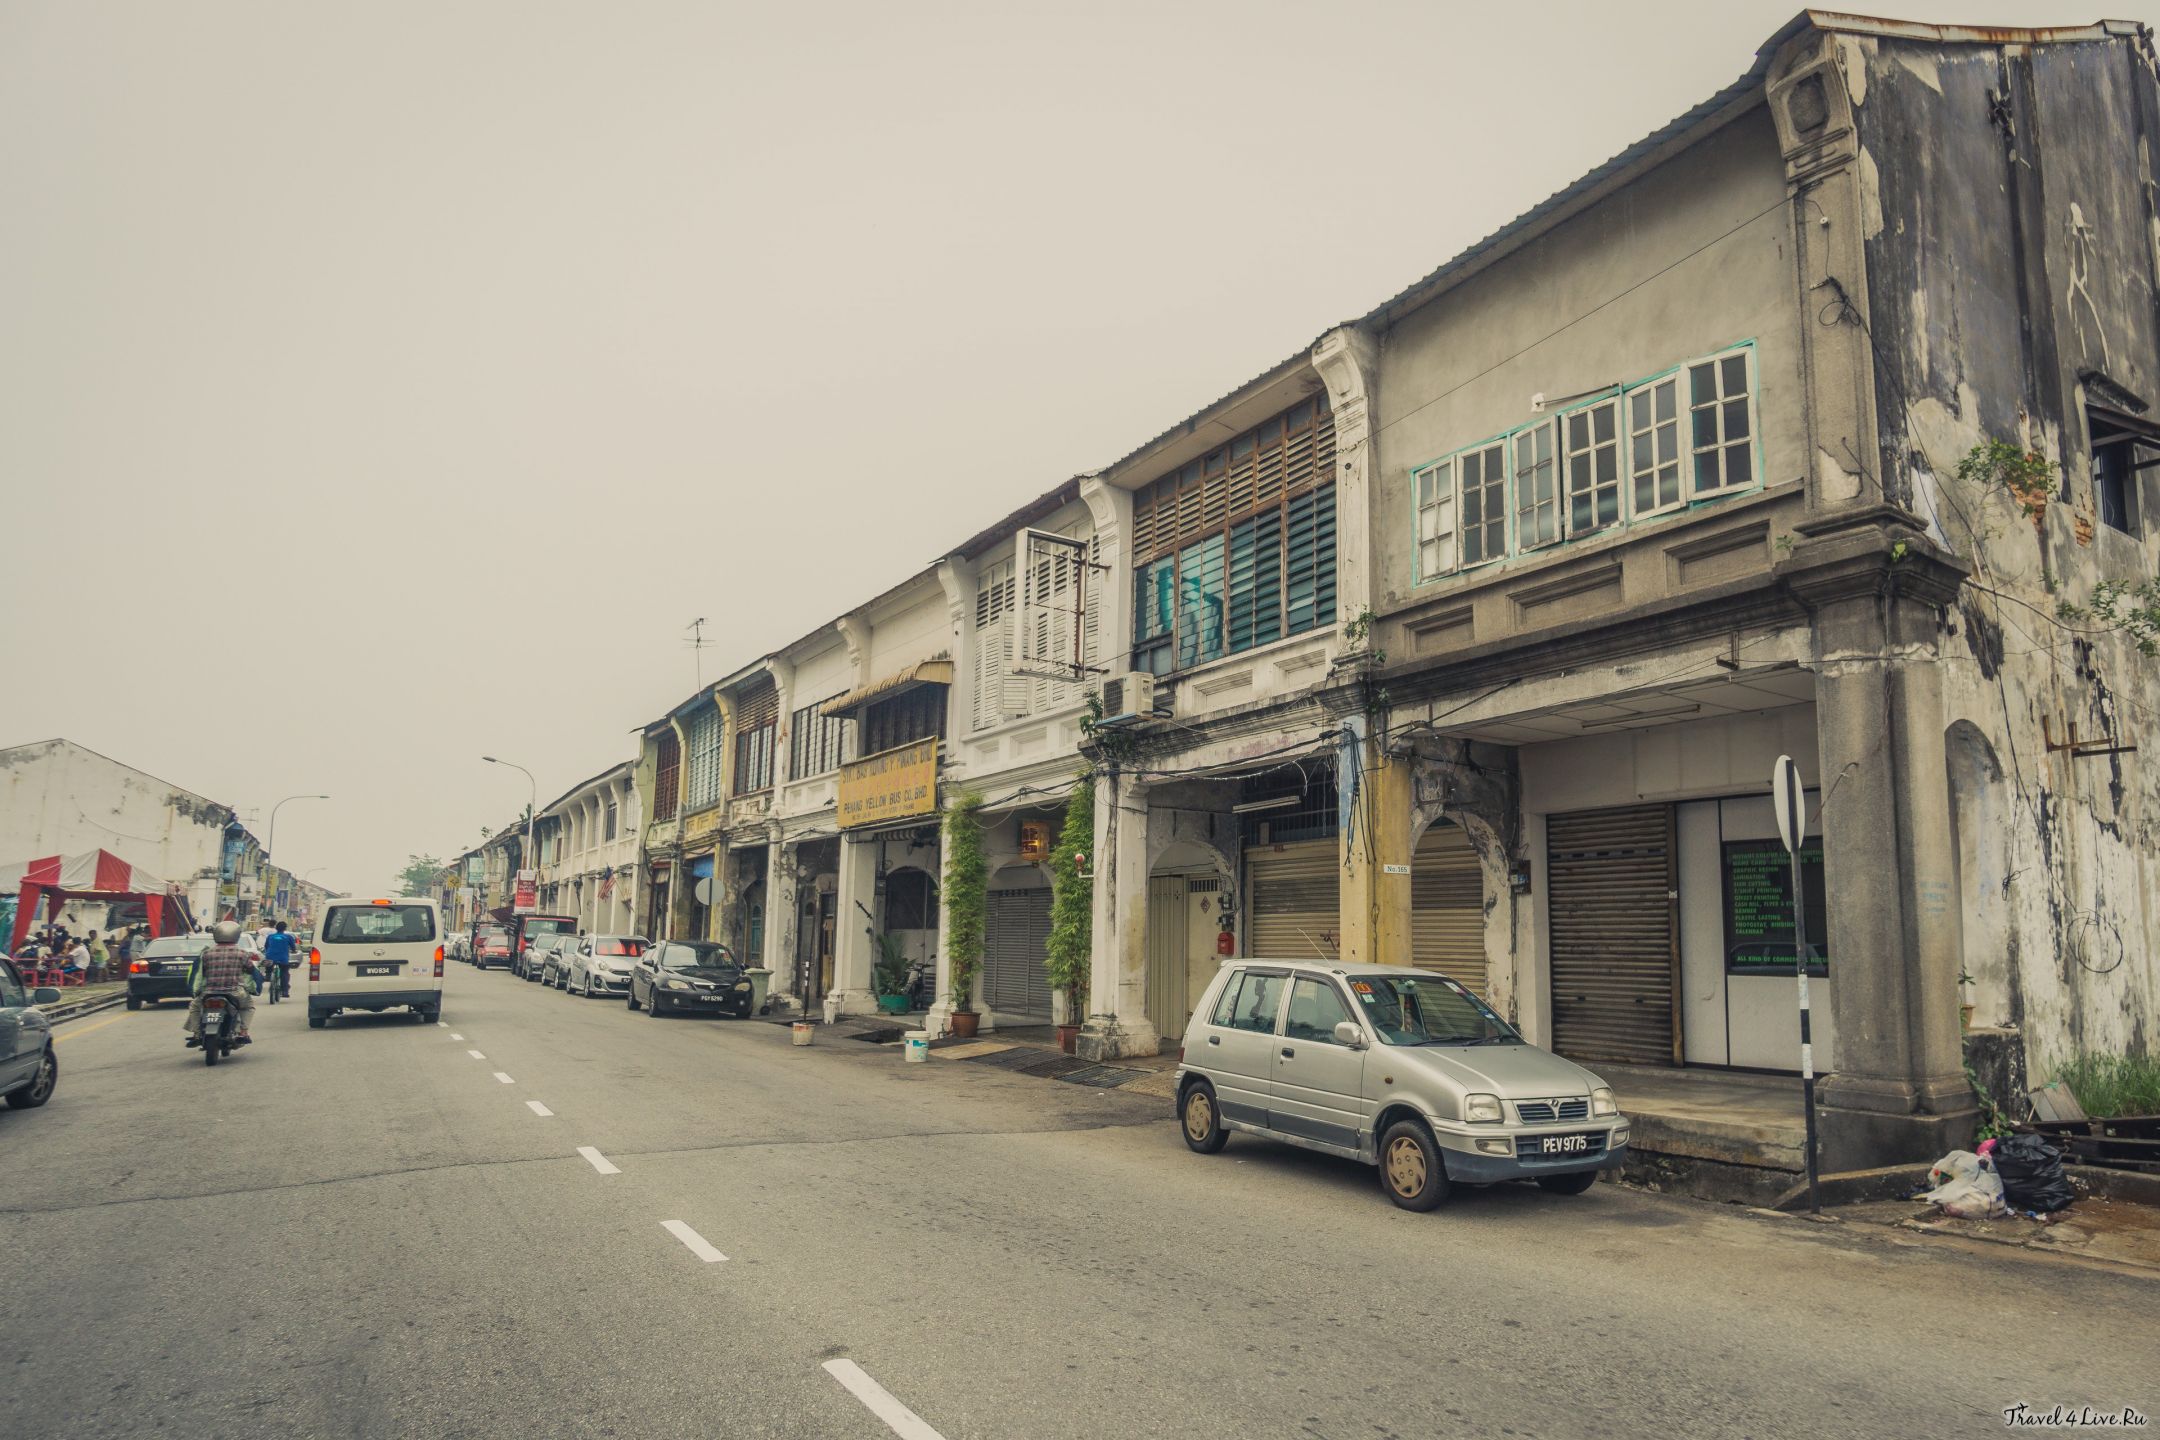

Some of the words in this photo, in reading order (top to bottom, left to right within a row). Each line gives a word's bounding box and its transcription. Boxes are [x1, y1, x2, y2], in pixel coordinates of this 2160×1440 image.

[865, 795, 887, 809] YELLOW
[889, 791, 900, 804] BUS
[904, 789, 912, 801] CO.
